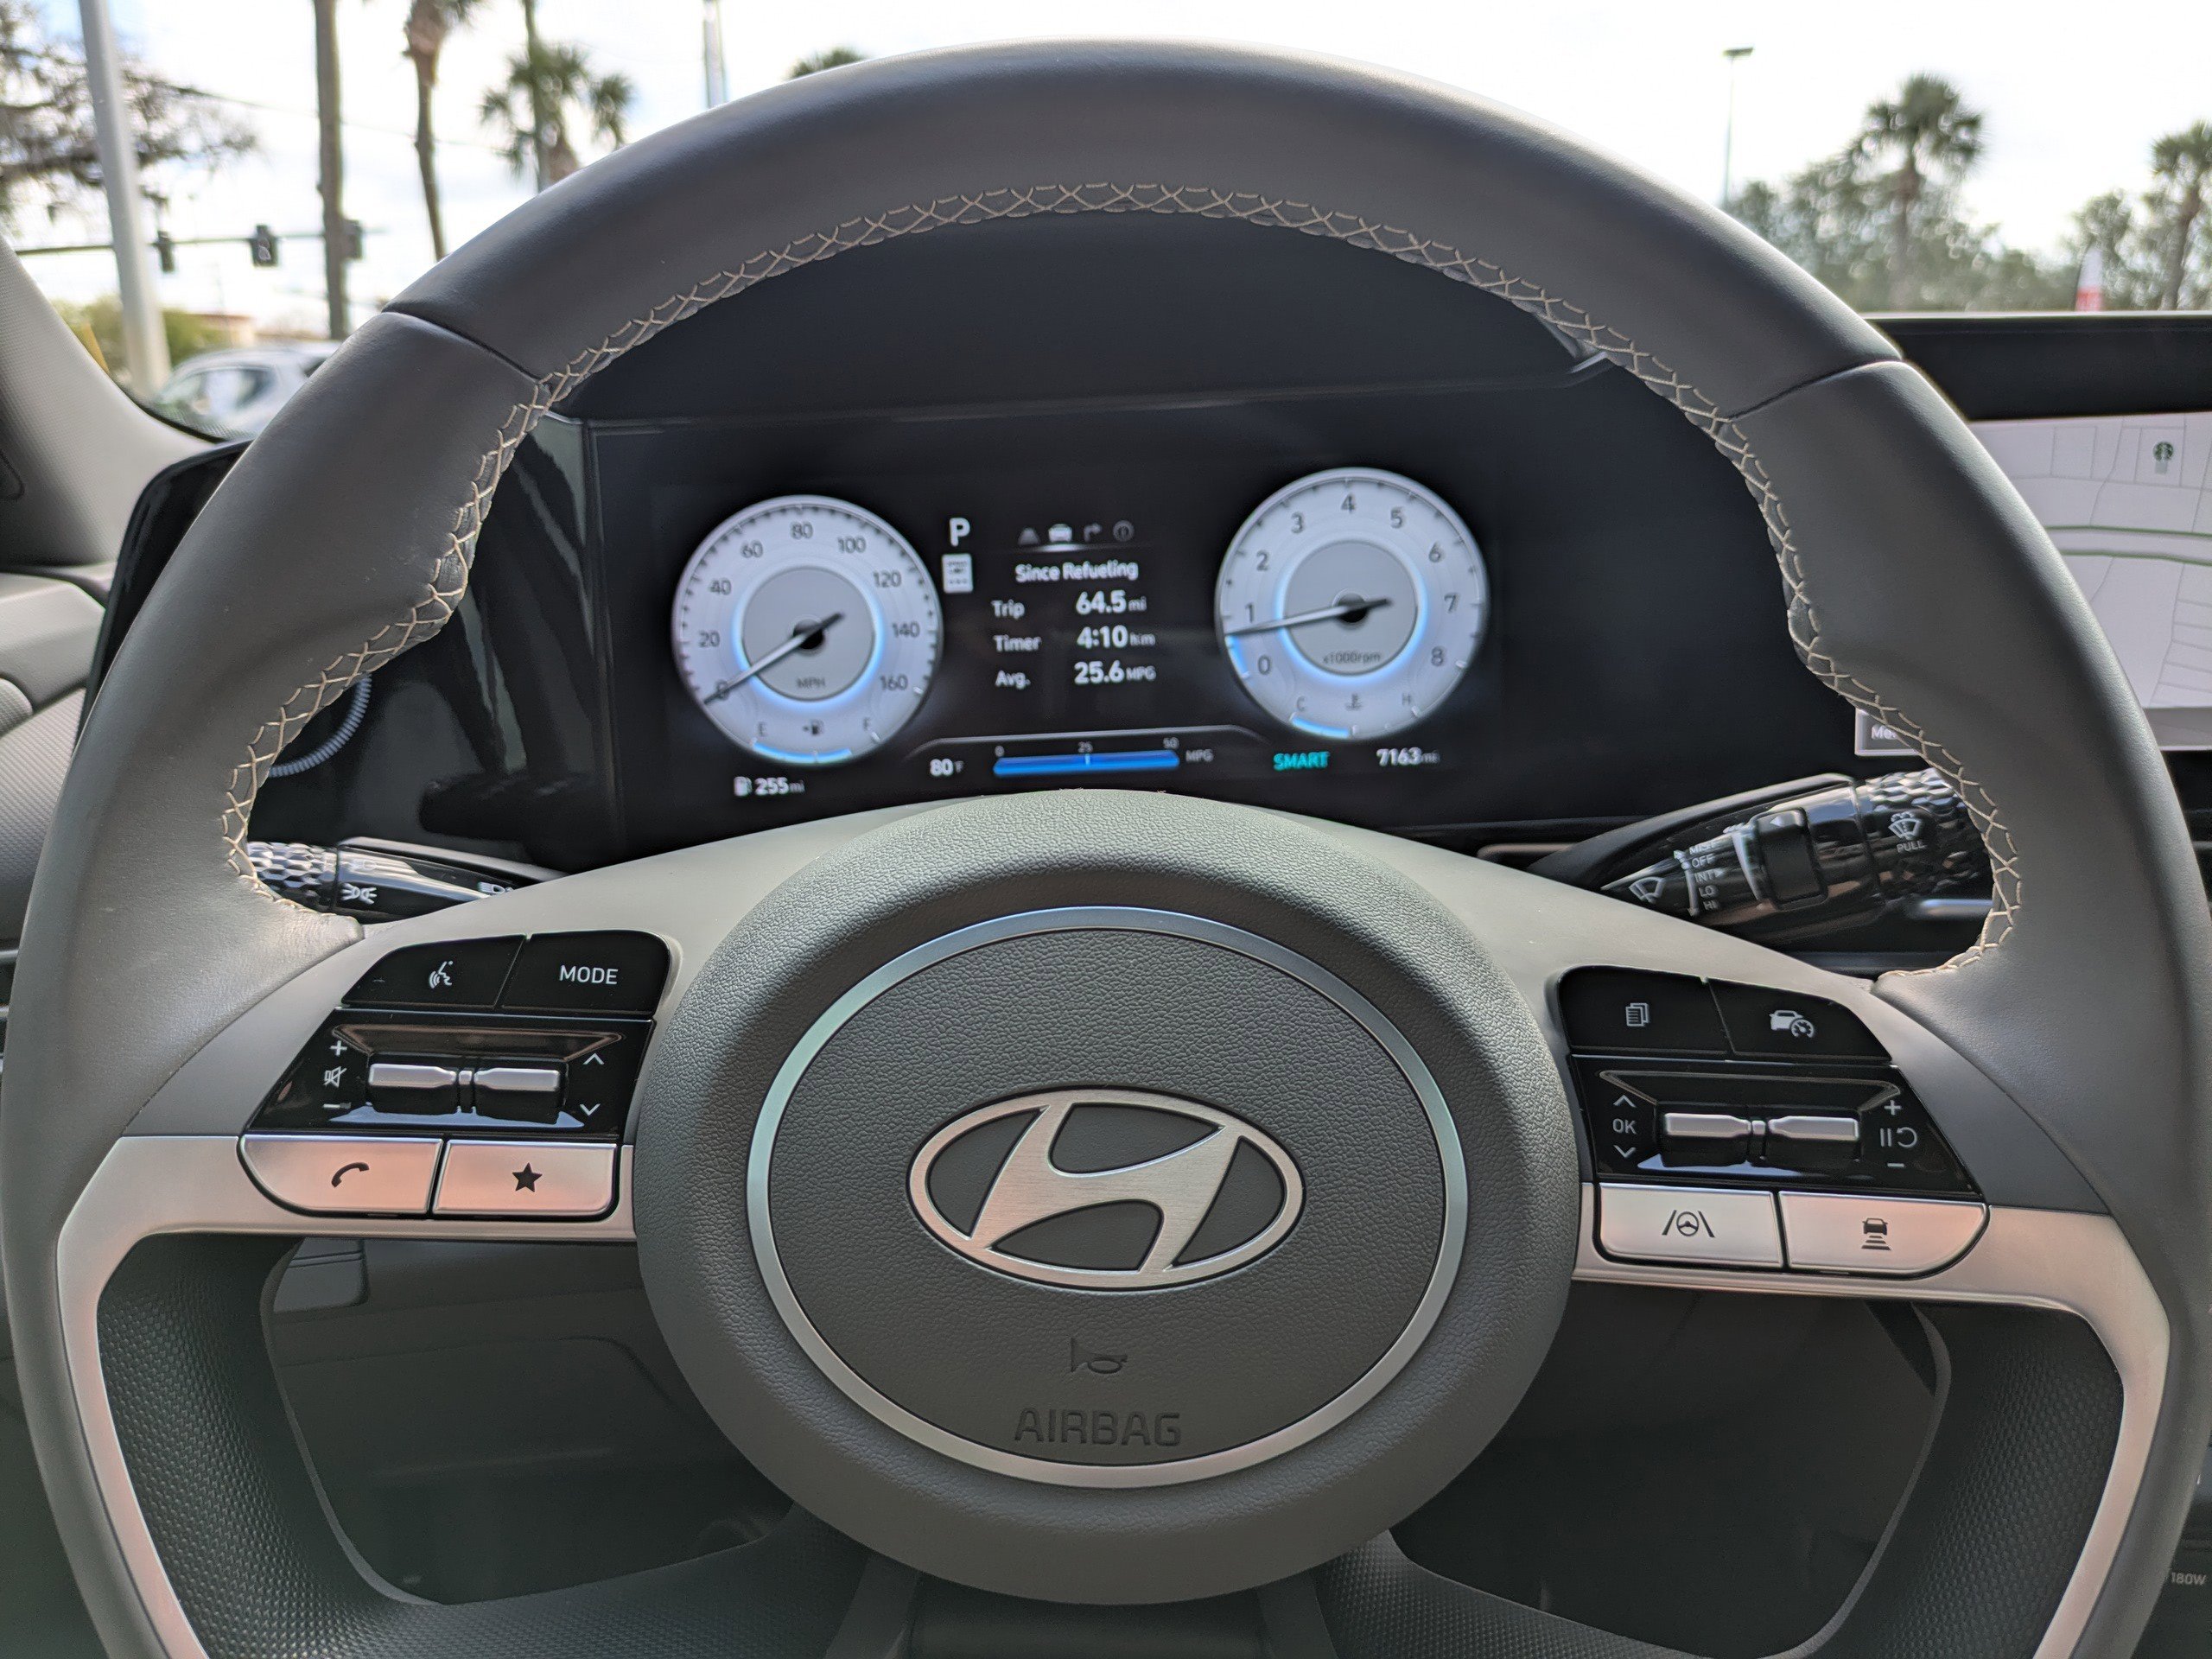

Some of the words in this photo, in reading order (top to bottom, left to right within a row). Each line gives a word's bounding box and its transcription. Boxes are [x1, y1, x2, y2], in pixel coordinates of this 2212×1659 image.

[1340, 493, 1356, 514] 4
[1292, 511, 1306, 535] 3
[1389, 505, 1404, 530] 5
[790, 520, 814, 540] 80
[950, 517, 970, 547] P
[740, 540, 764, 559] 60
[836, 536, 867, 554] 100
[1428, 542, 1443, 563] 6
[1255, 550, 1269, 572] 2
[873, 570, 902, 588] 120
[1014, 563, 1060, 583] Since
[1062, 560, 1139, 581] Refueling
[709, 579, 732, 596] 40
[991, 600, 1025, 620] Trip
[1244, 602, 1255, 623] 1
[1444, 593, 1459, 614] 7
[698, 630, 721, 648] 20
[892, 620, 921, 639] 140
[993, 634, 1041, 653] Timer
[1257, 654, 1272, 676] 0
[1431, 645, 1446, 667] 8
[880, 674, 909, 691] 160
[995, 671, 1031, 690] Avg.
[1273, 750, 1330, 772] SMART
[1896, 840, 1928, 854] PULL
[1691, 853, 1716, 868] OFF
[1698, 885, 1719, 899] LO
[559, 965, 620, 986] MODE
[1612, 1117, 1637, 1135] OK
[1014, 1407, 1182, 1447] AIRBAG
